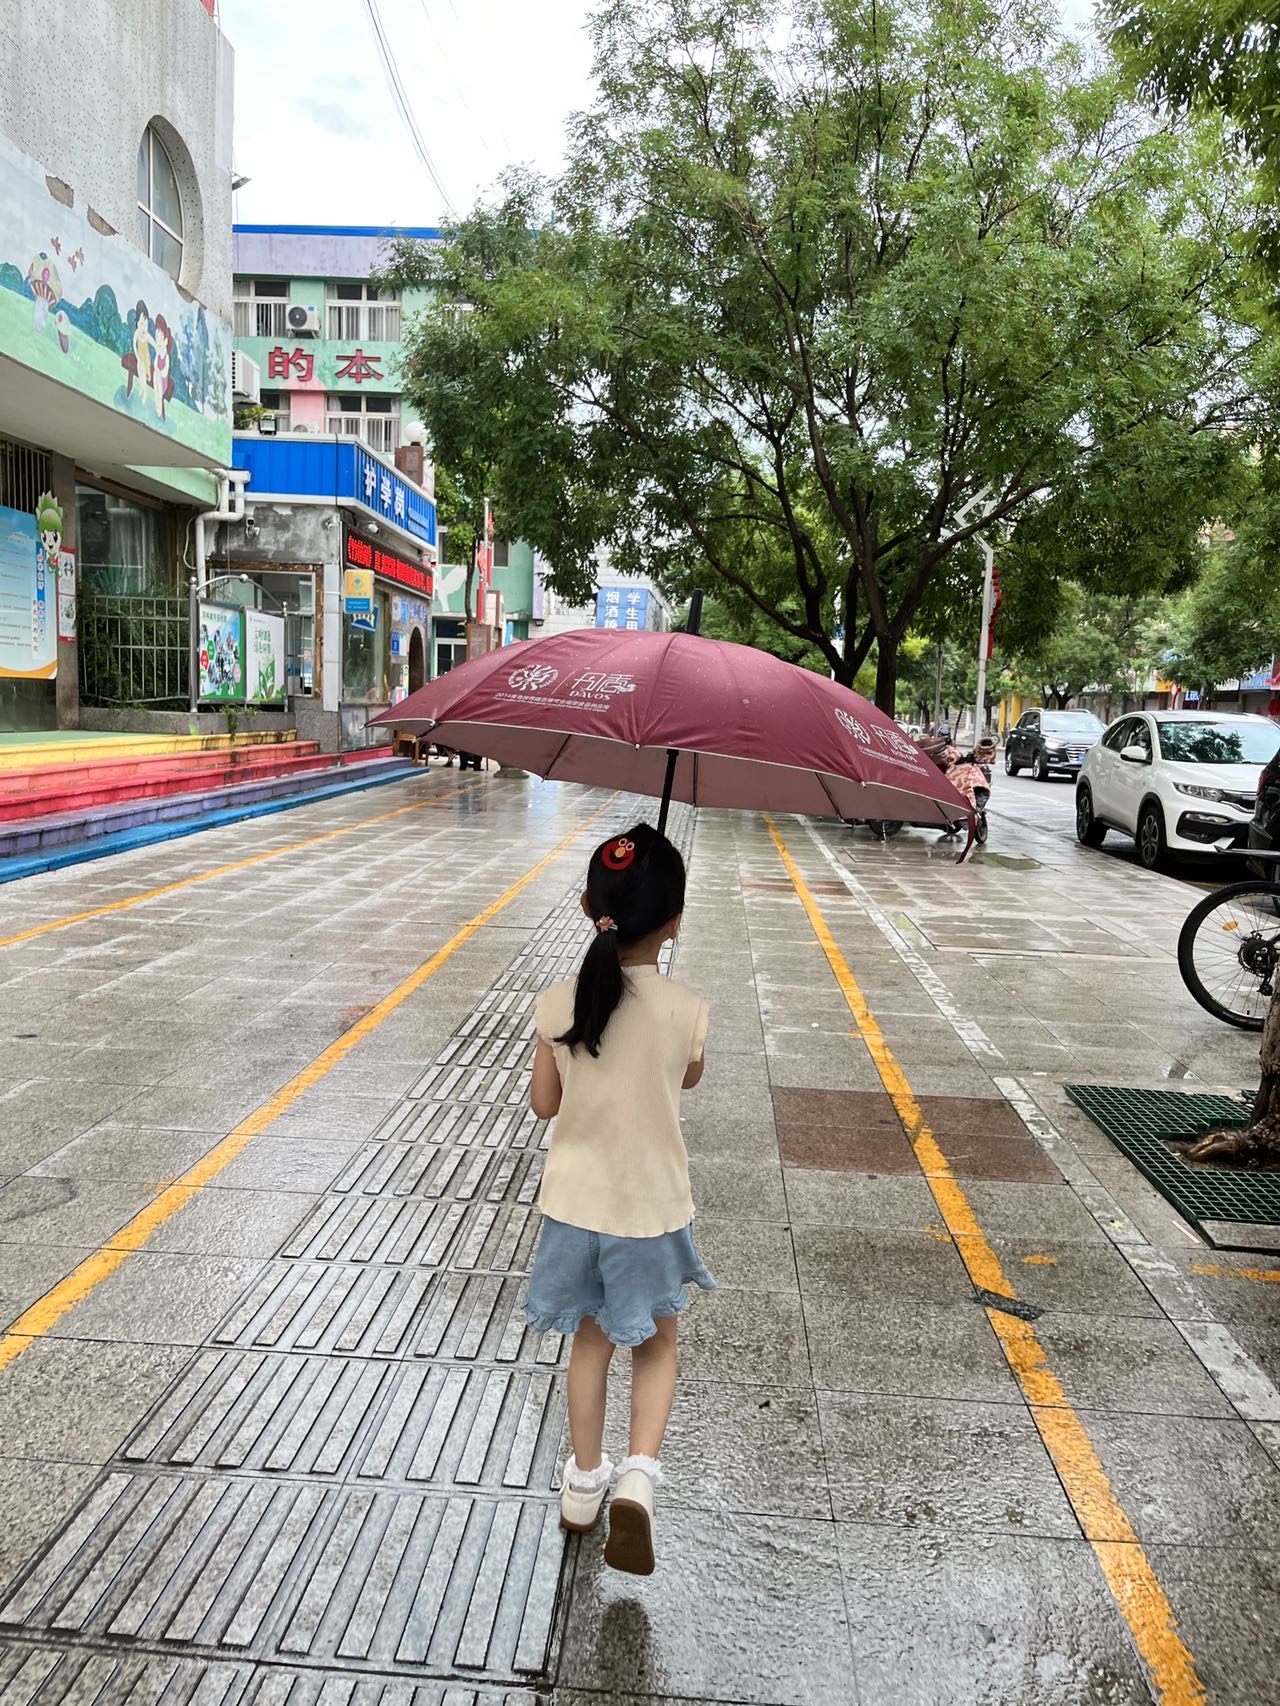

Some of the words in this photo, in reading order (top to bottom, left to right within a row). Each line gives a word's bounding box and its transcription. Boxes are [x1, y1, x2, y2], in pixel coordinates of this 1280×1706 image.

[364, 463, 405, 519] 护学岗
[569, 690, 612, 700] DAVOS
